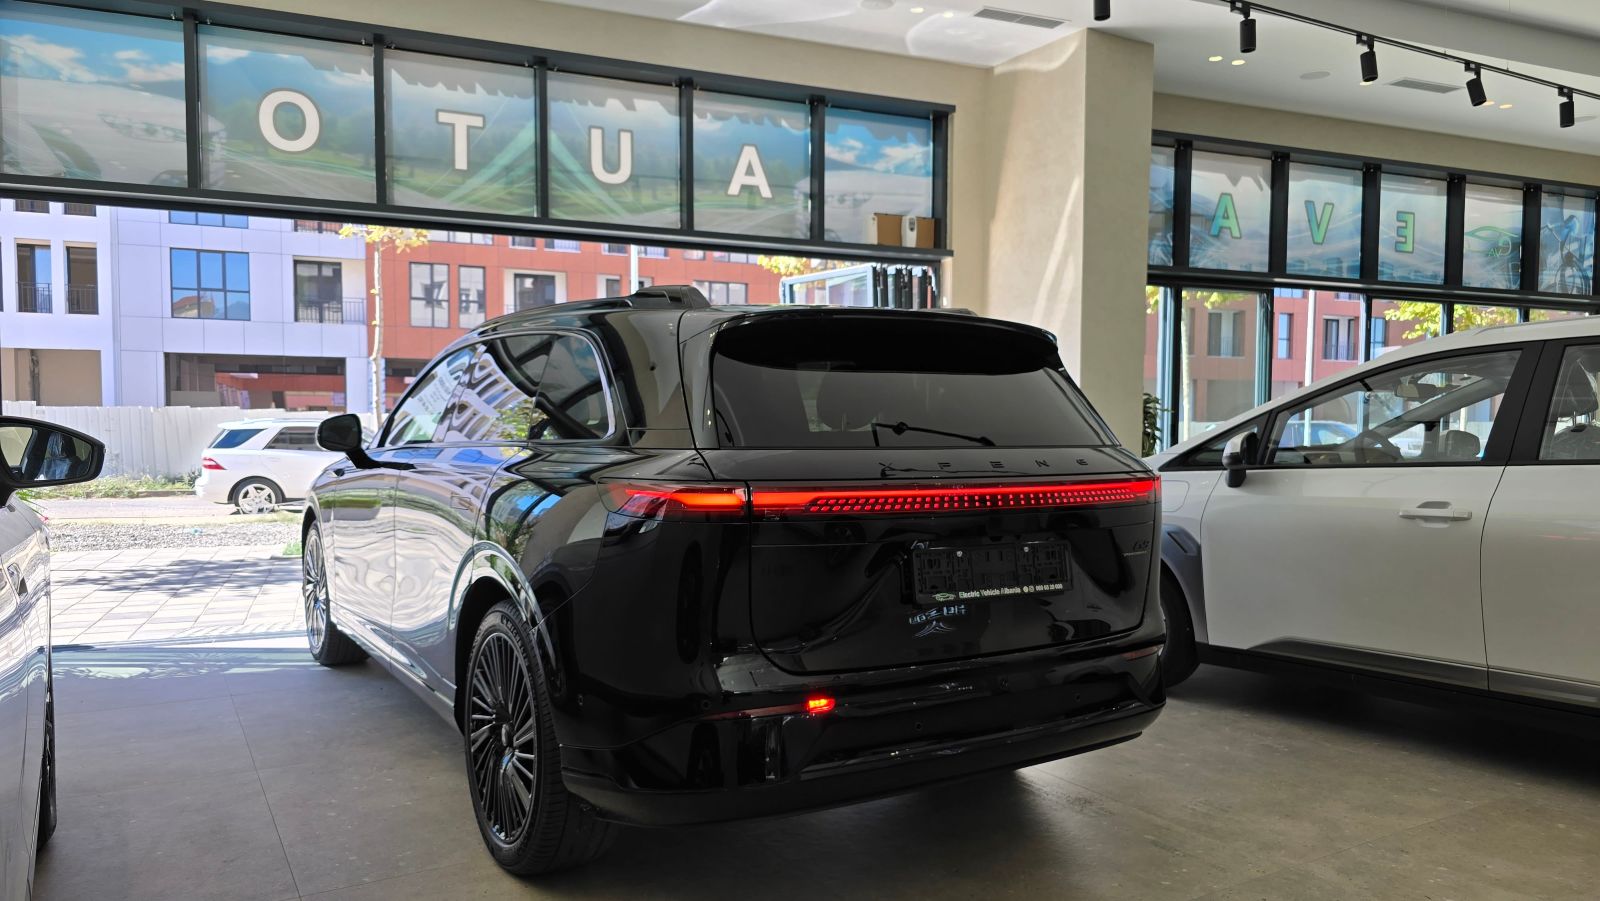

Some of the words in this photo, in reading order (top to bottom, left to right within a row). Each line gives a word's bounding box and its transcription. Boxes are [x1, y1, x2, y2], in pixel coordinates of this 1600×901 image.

[958, 590, 980, 599] Electric
[980, 588, 1001, 597] Vehicle
[1001, 586, 1021, 595] Albania
